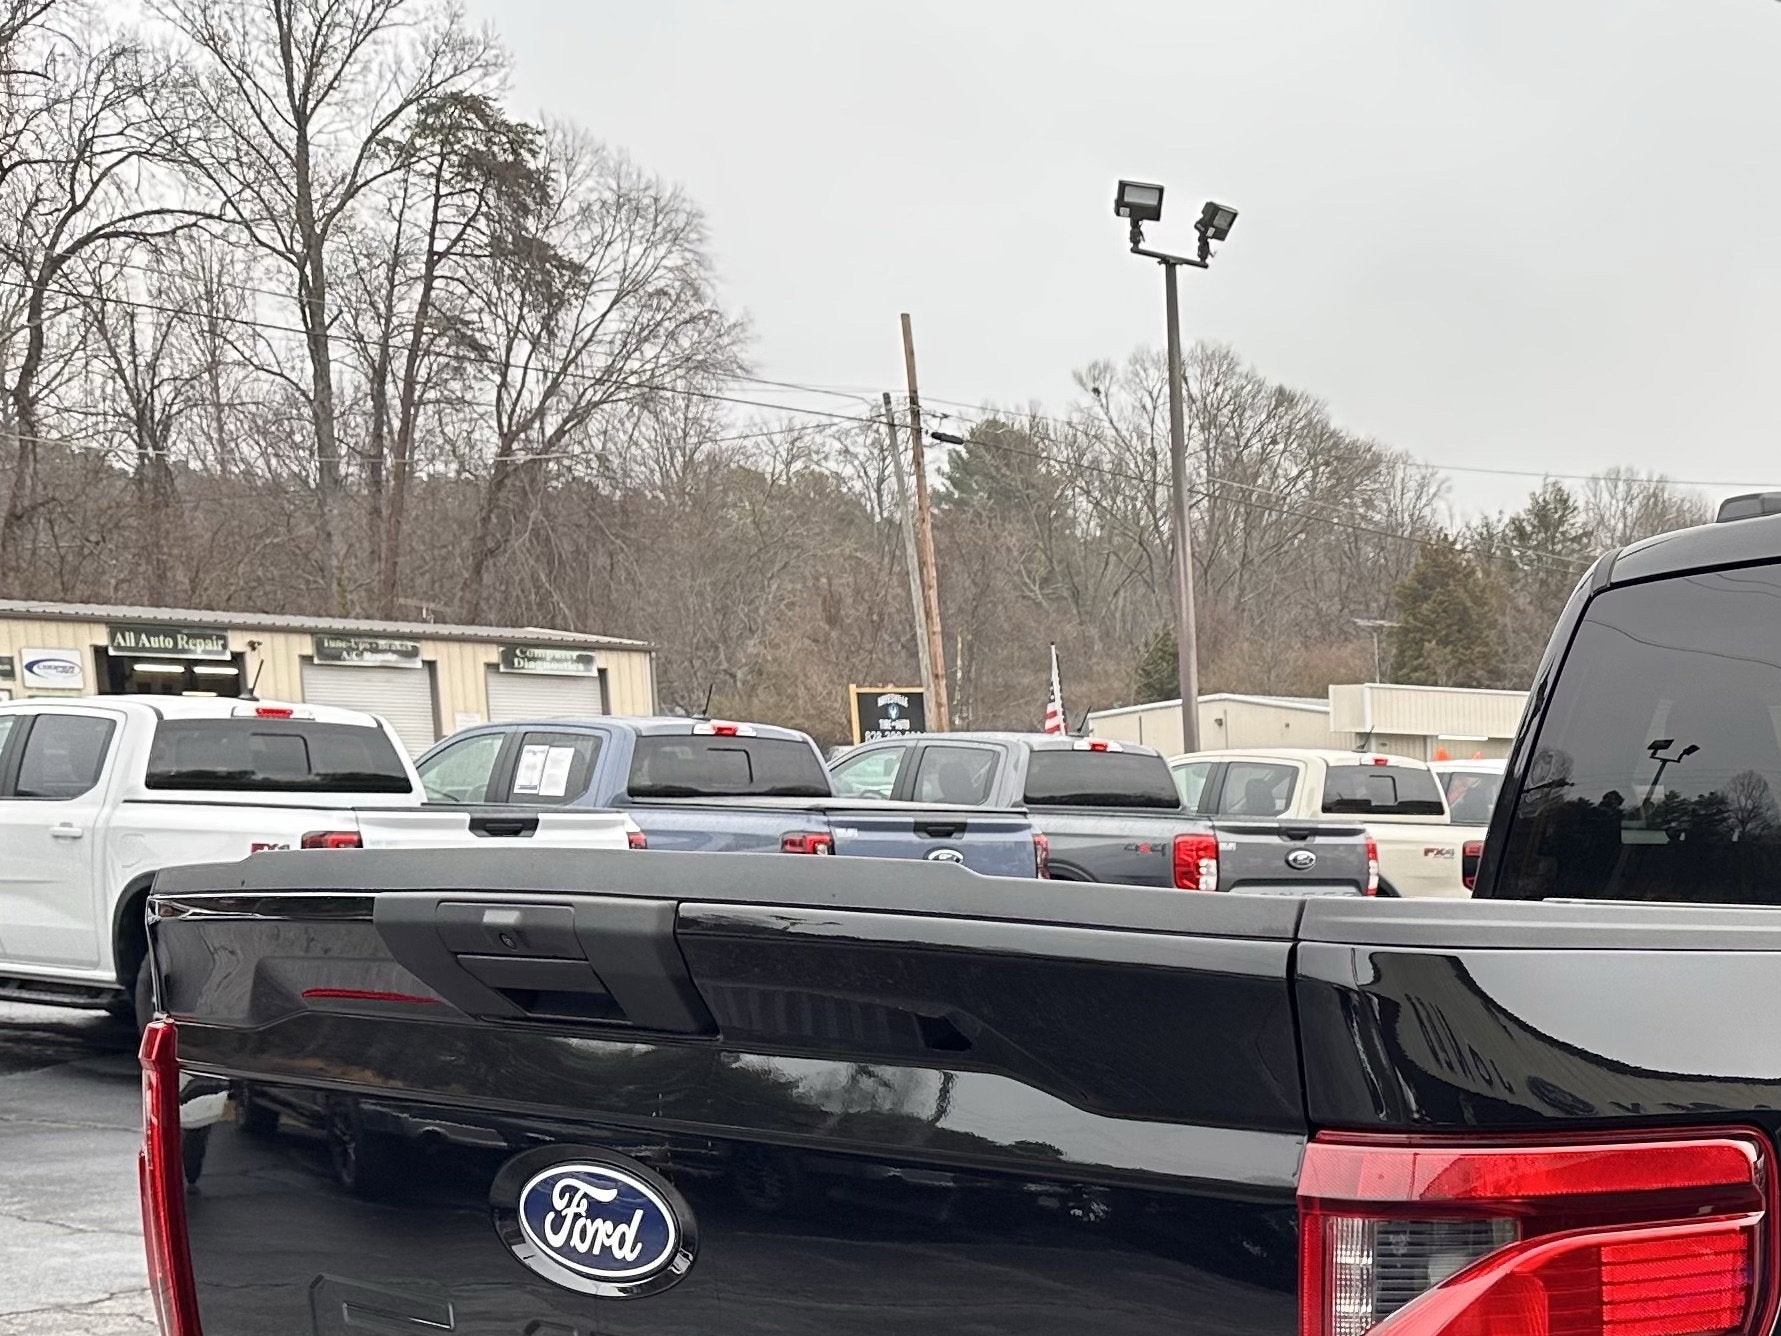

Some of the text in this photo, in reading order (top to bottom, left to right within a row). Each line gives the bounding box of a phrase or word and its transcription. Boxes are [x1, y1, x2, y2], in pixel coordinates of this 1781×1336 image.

[114, 631, 224, 654] All Auto Repair
[544, 1177, 644, 1262] Ford
